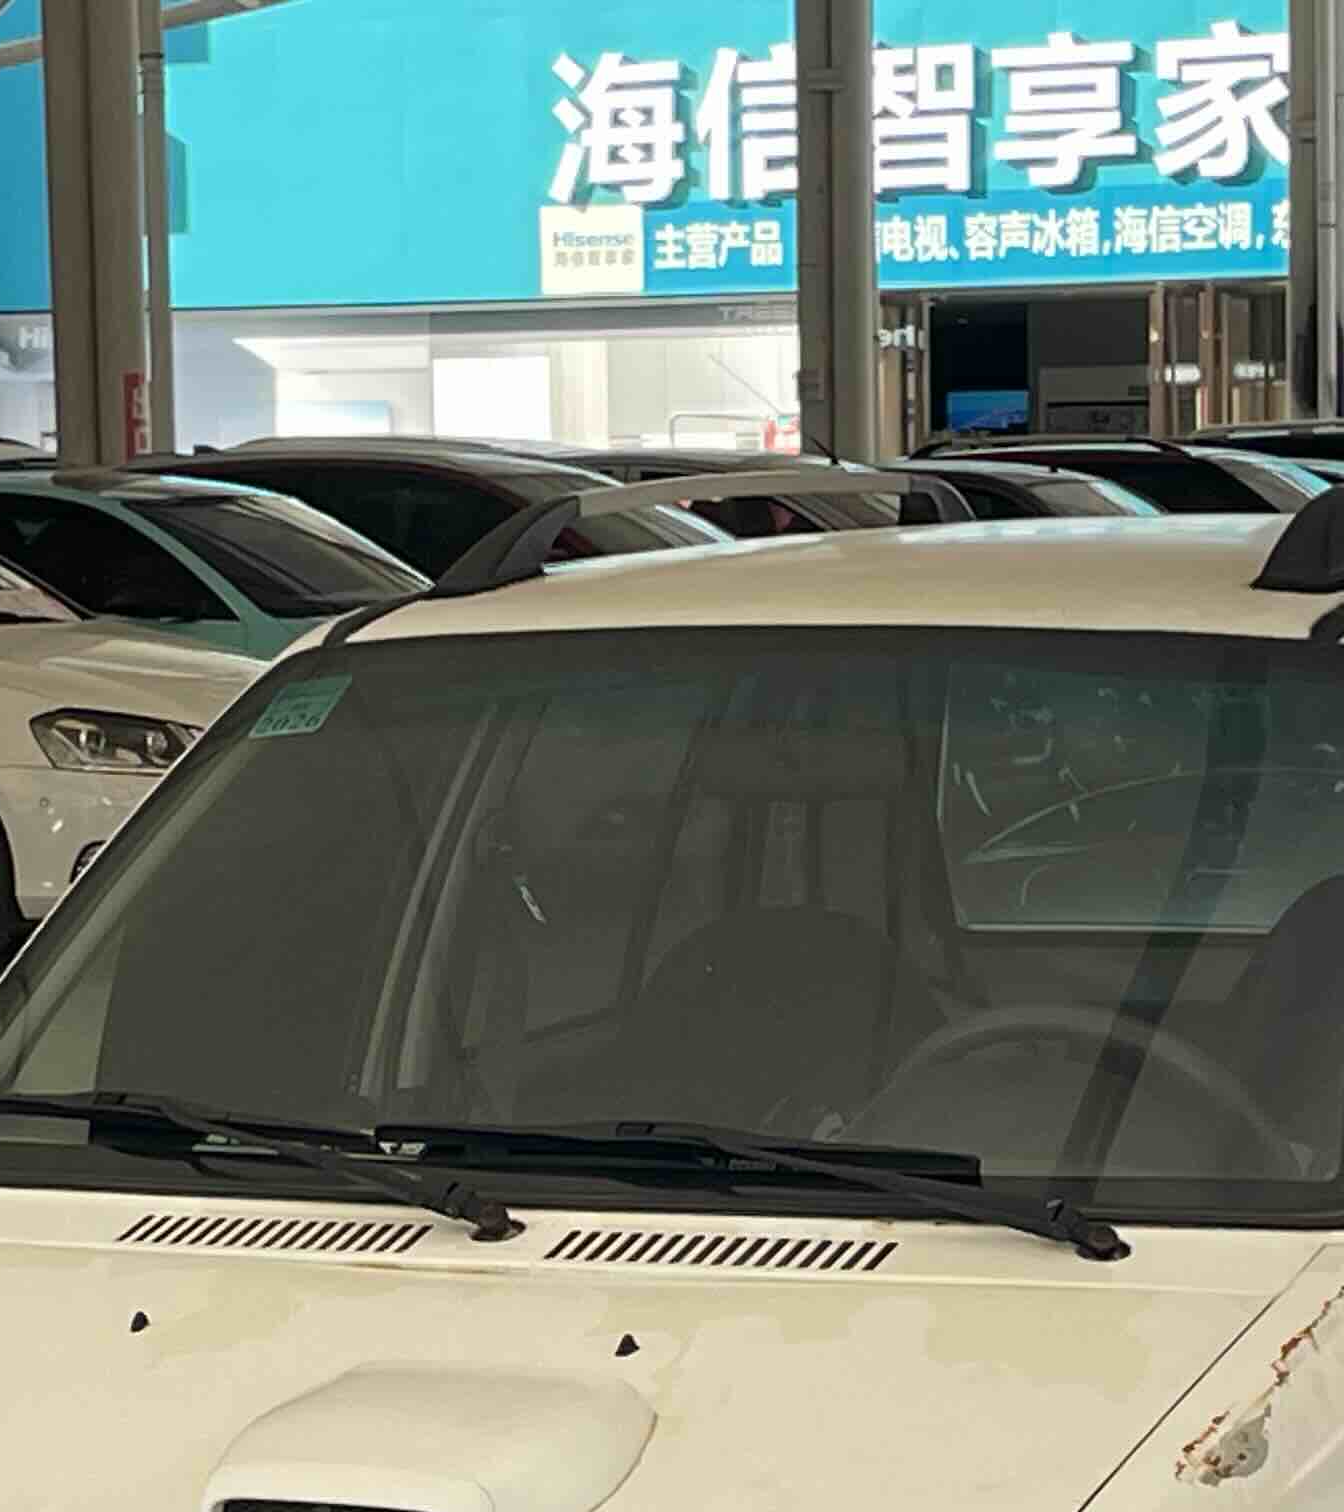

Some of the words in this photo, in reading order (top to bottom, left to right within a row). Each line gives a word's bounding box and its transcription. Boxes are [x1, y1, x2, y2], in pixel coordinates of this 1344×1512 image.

[548, 22, 1291, 205] 海信智享家
[653, 220, 784, 270] 主营产品
